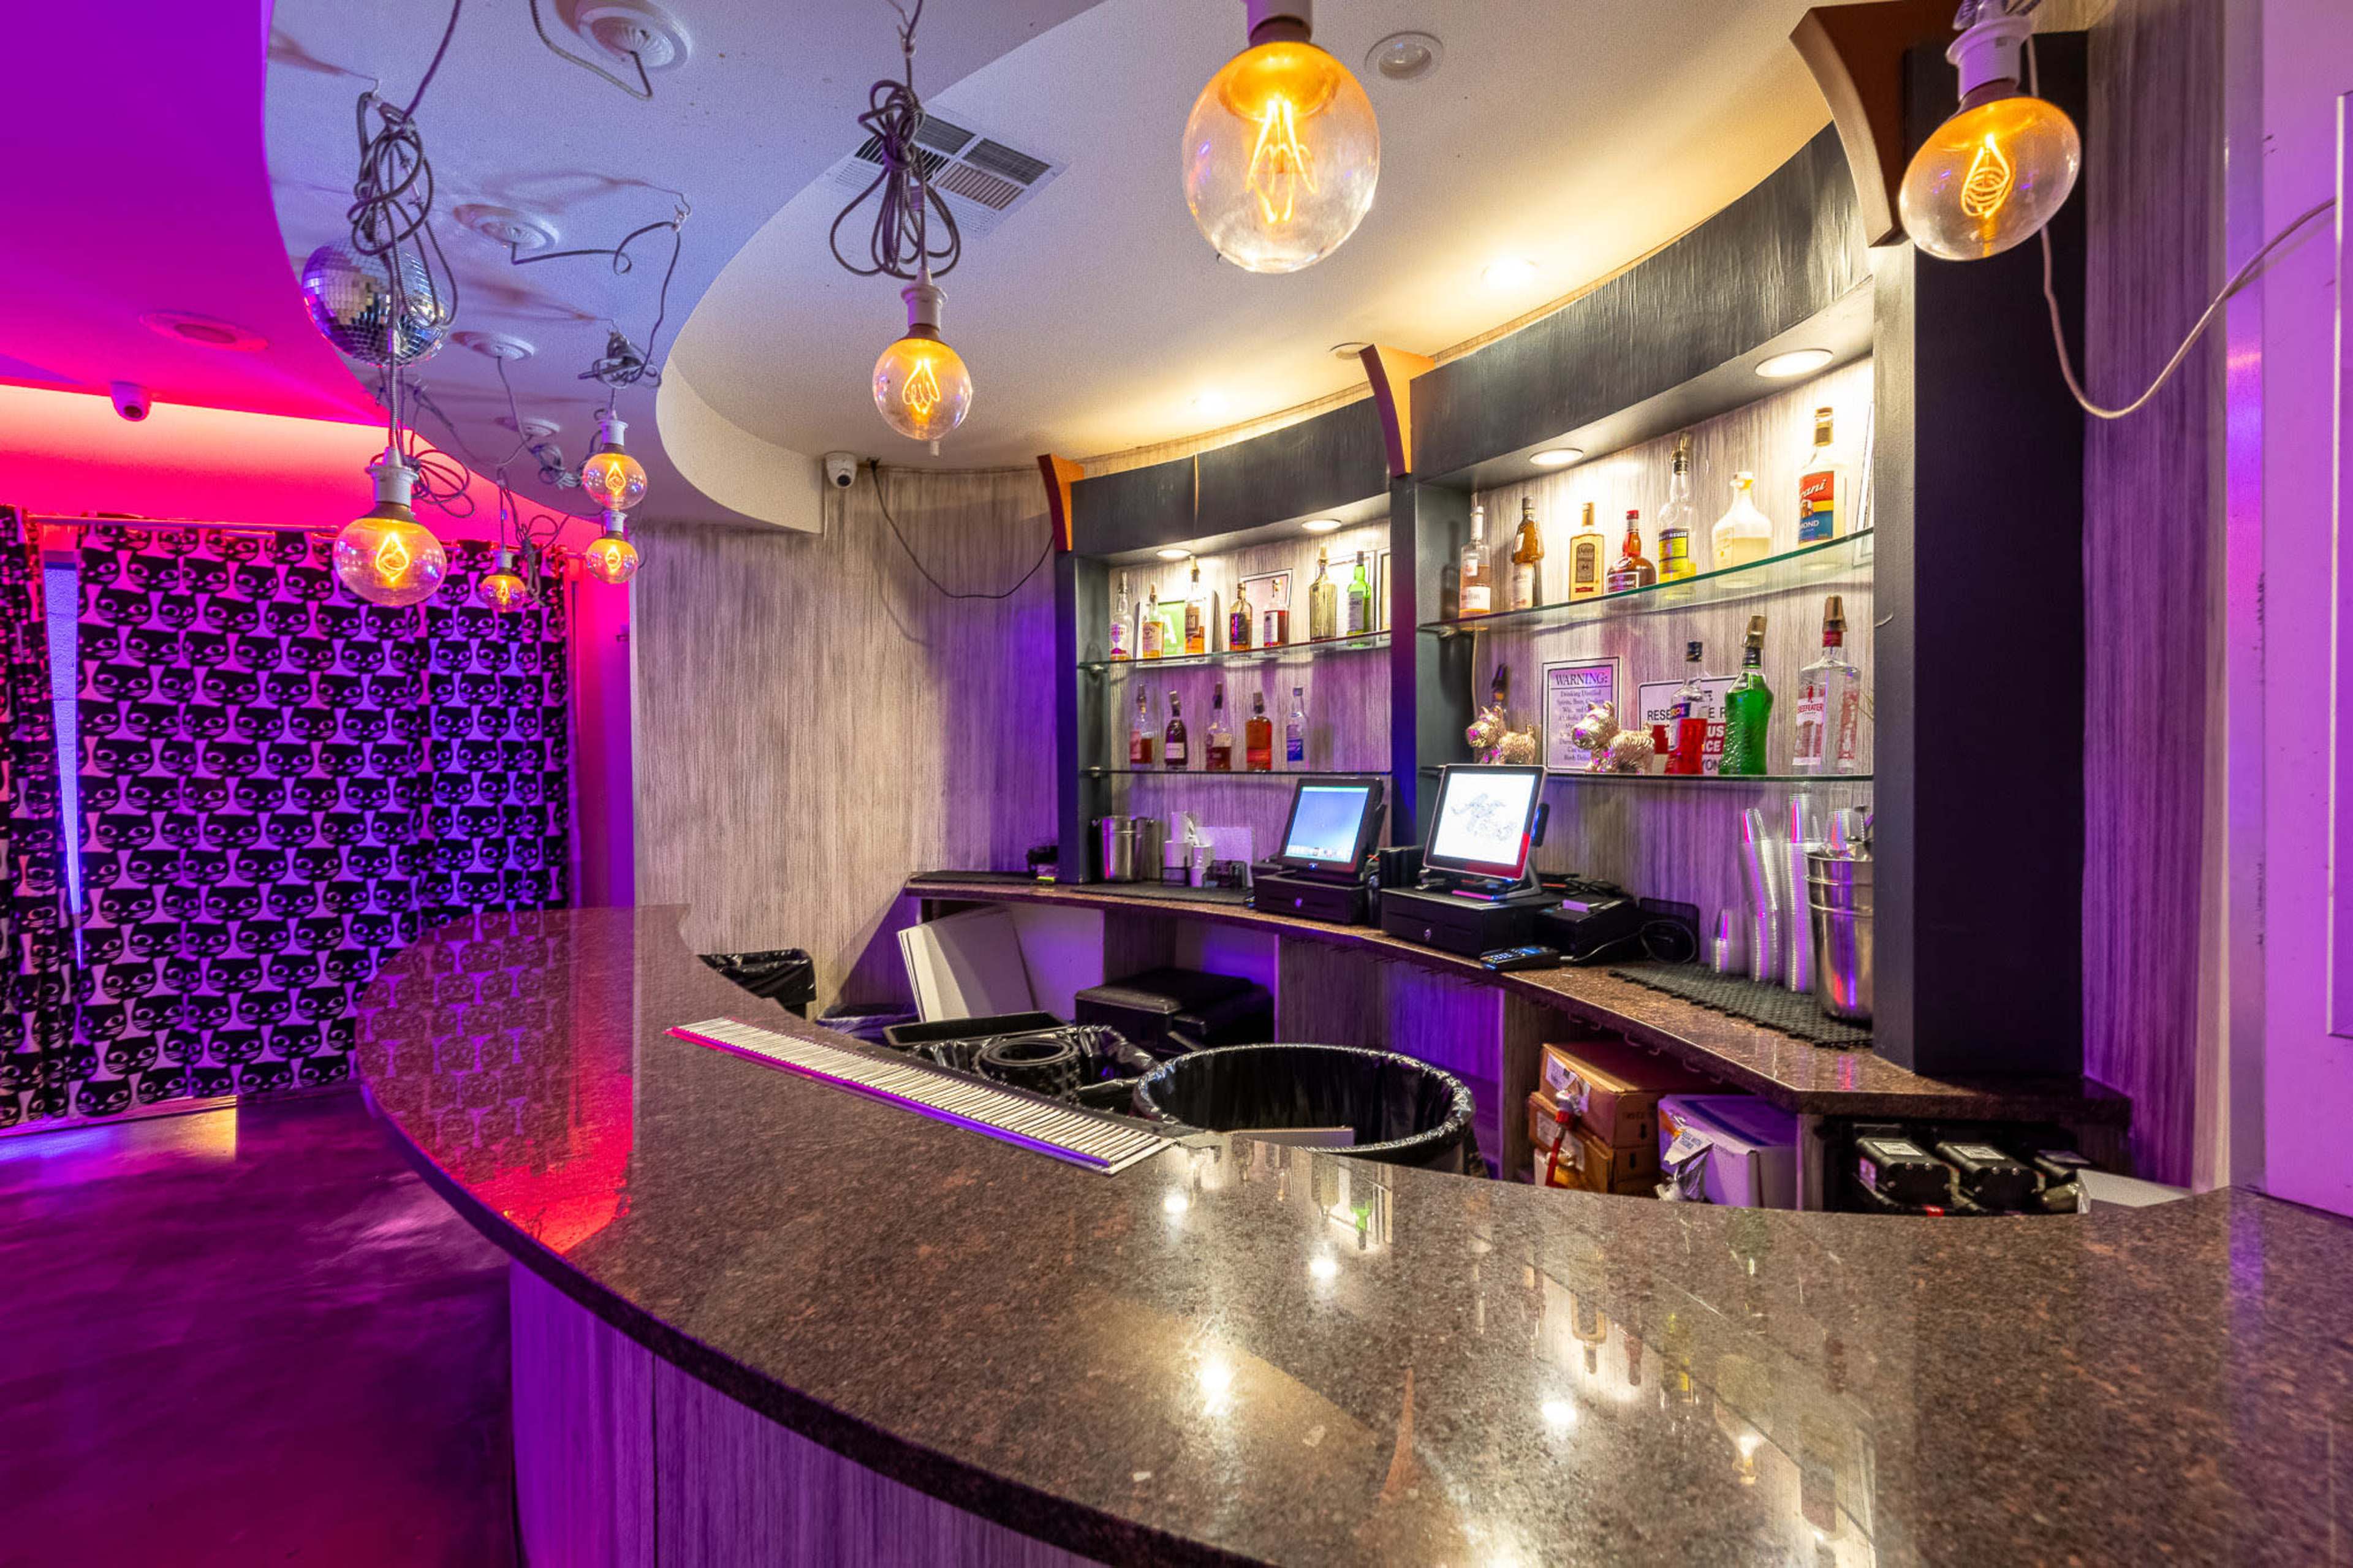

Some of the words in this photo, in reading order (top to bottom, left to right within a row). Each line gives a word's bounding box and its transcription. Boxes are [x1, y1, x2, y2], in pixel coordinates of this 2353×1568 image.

[1800, 479, 1827, 498] rani
[1800, 520, 1819, 529] OND
[1555, 672, 1608, 686] WARNING:
